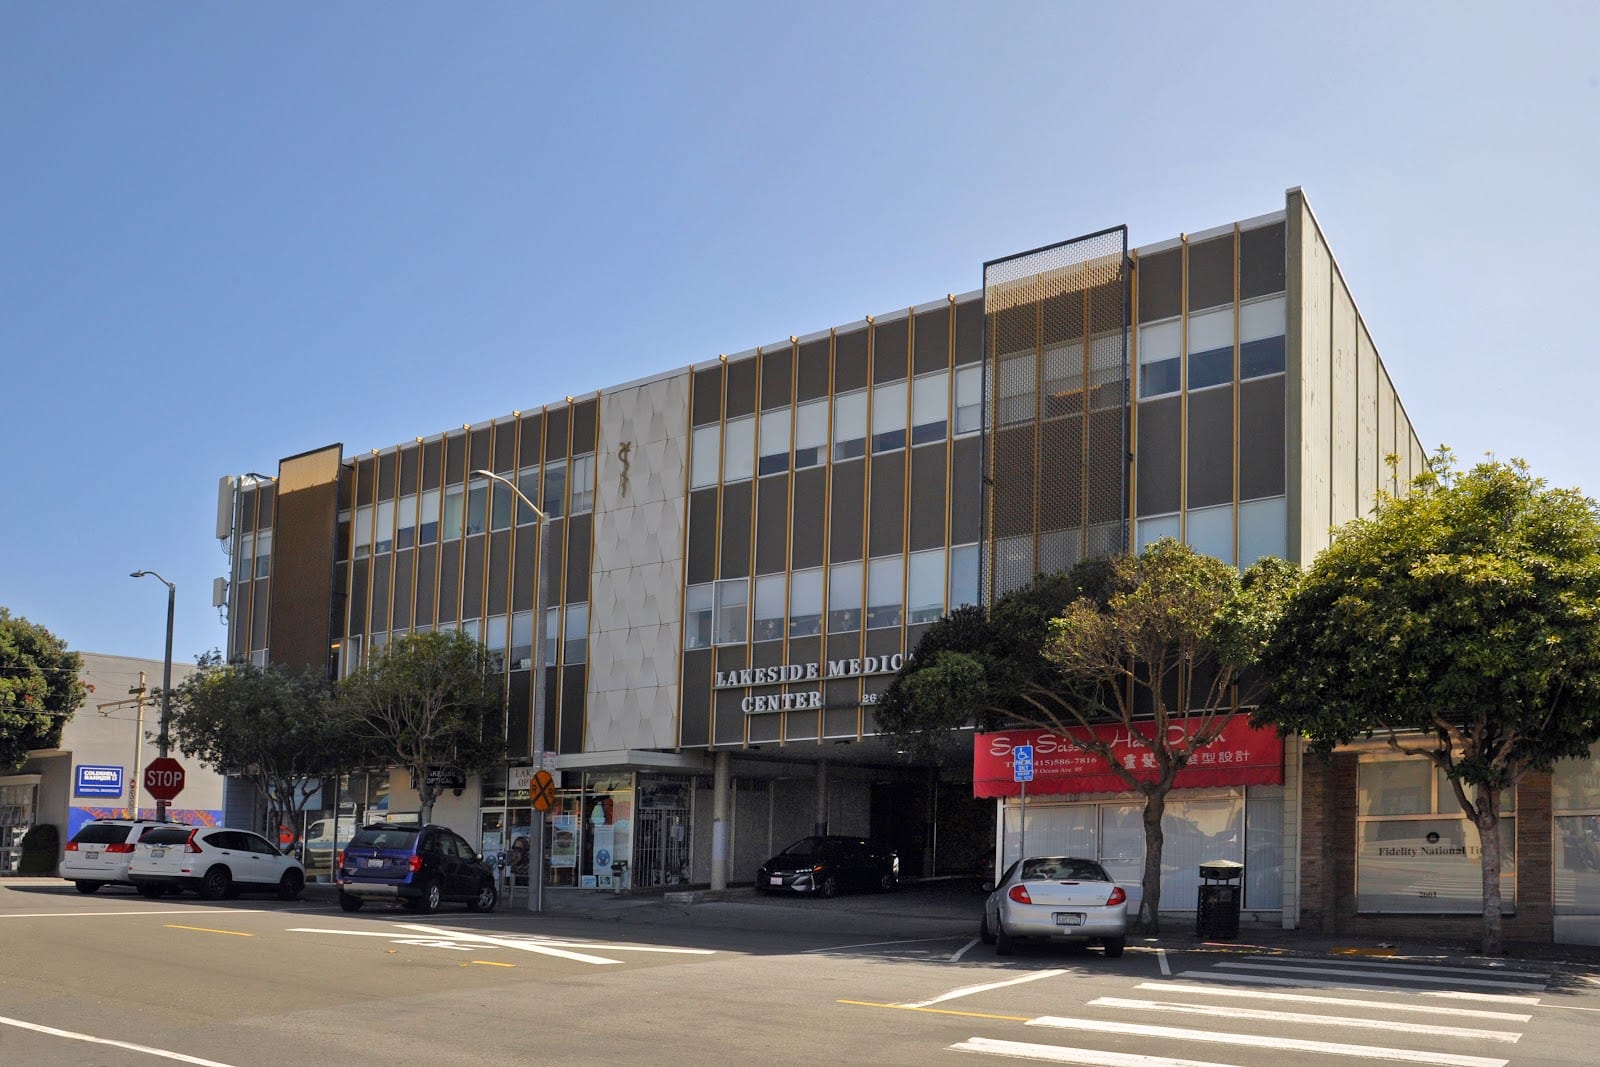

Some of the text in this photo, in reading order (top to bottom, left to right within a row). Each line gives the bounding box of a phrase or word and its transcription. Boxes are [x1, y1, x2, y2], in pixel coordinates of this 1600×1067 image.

[717, 662, 819, 687] LAKESIDE
[742, 691, 822, 713] CENTER
[1033, 757, 1097, 768] 415)586-7816
[147, 770, 182, 787] STOP
[1379, 847, 1417, 857] Fidelity
[1421, 846, 1465, 856] National
